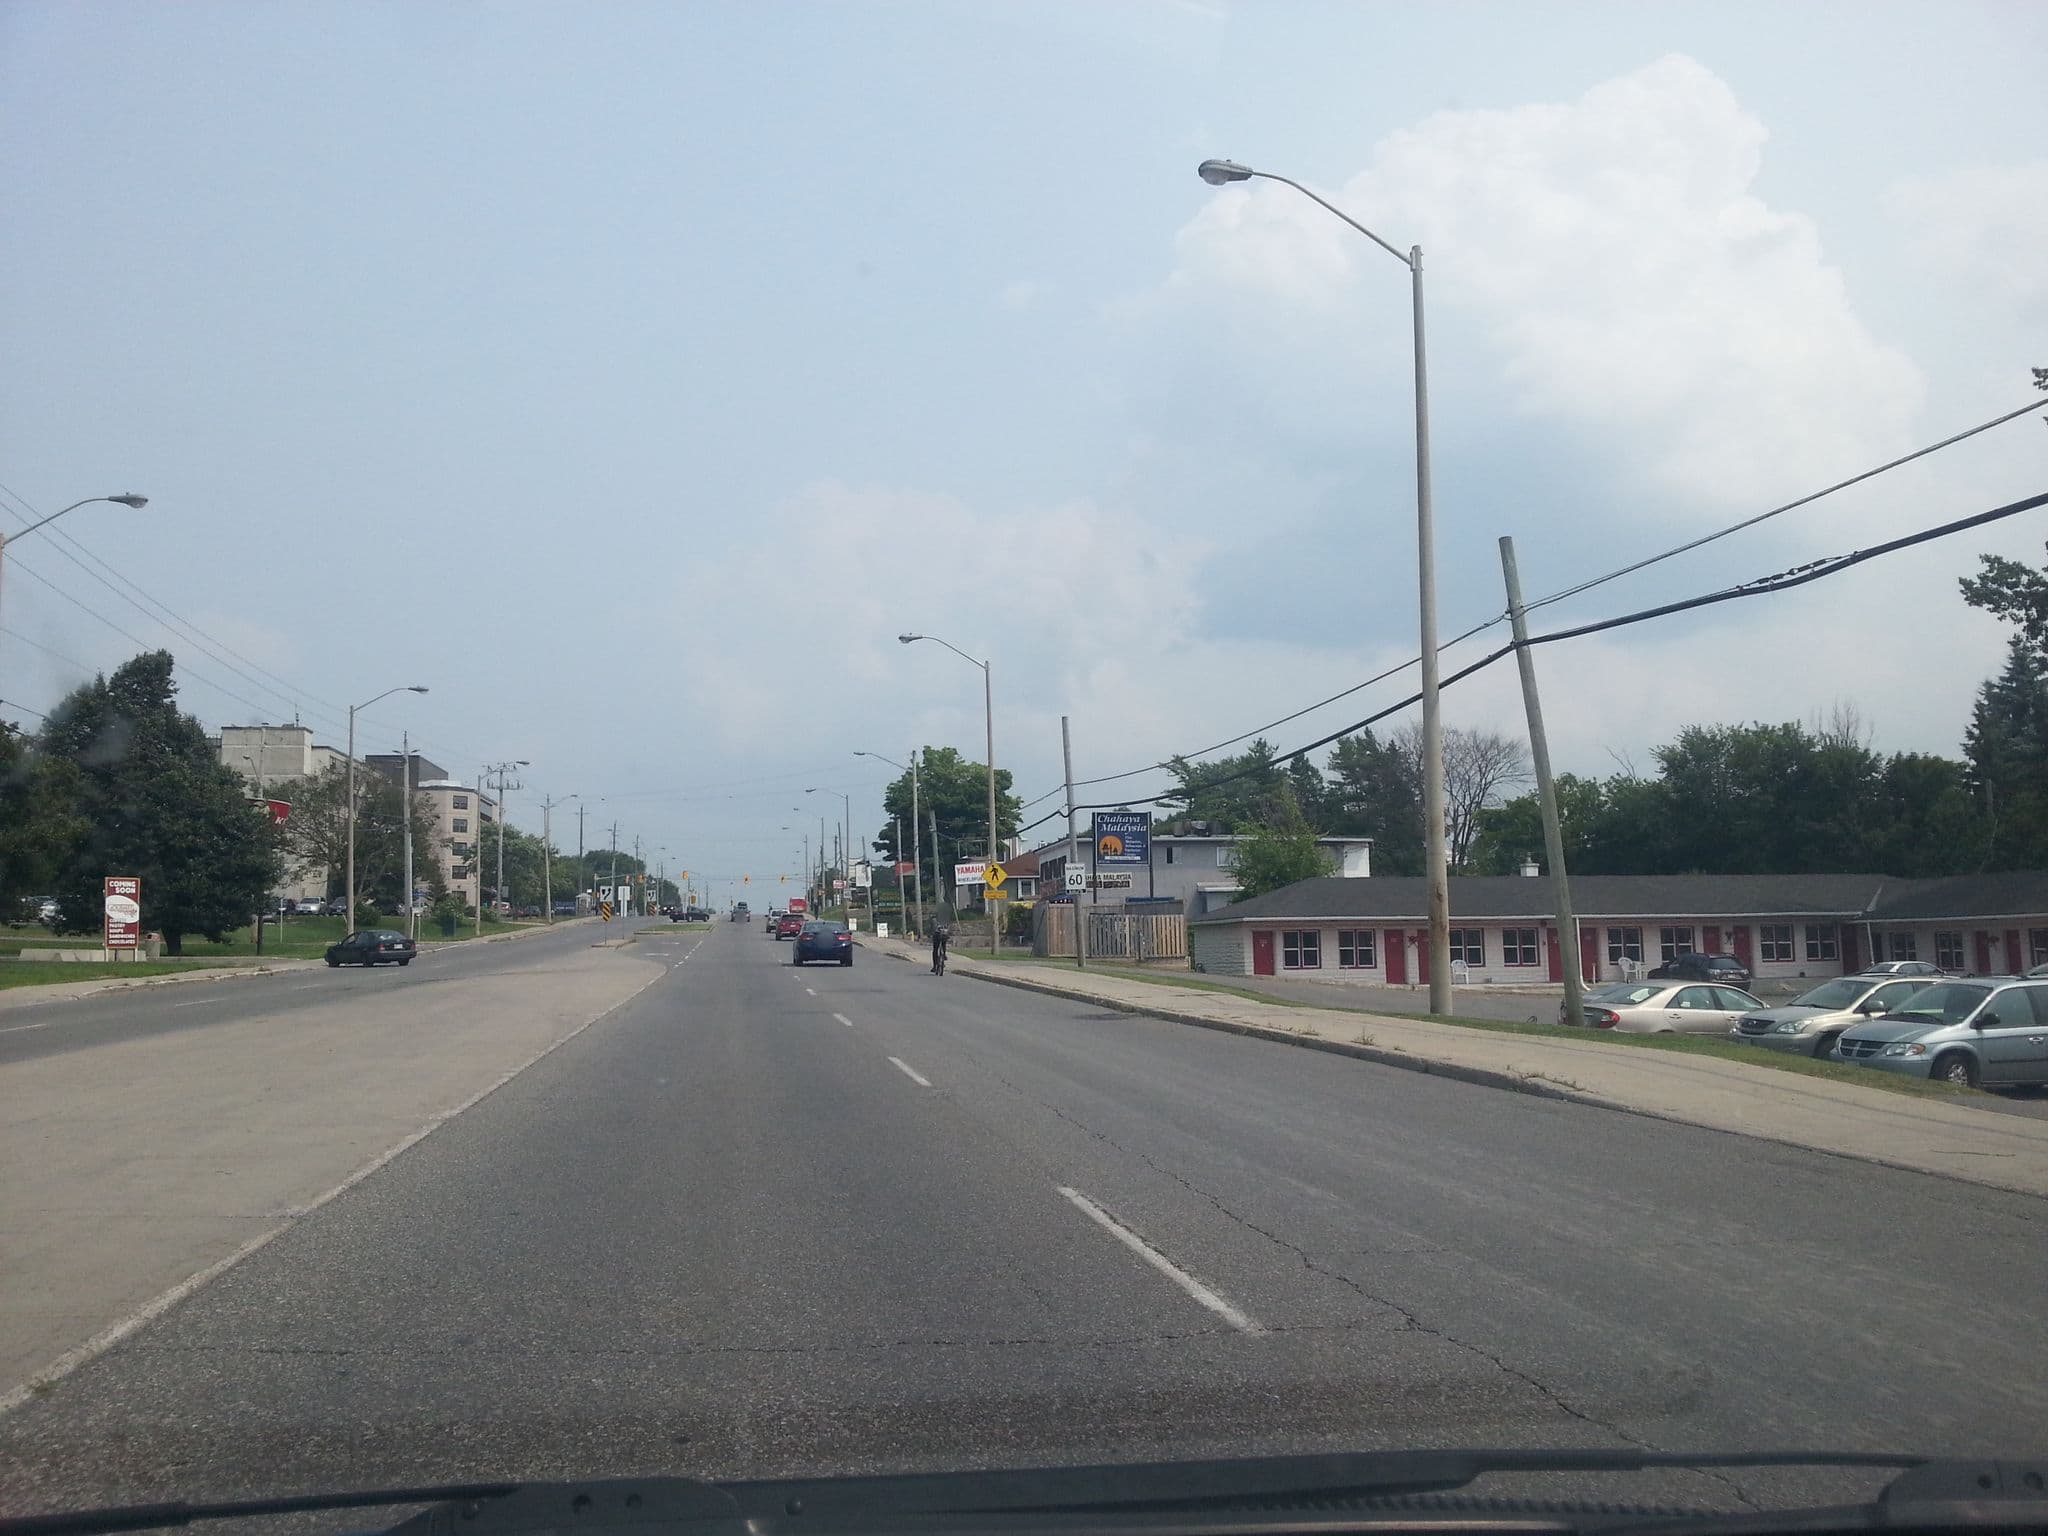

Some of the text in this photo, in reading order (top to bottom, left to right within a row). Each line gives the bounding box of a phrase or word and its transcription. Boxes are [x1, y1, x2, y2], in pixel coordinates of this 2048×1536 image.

[1097, 814, 1140, 823] Chahaya
[1100, 823, 1147, 834] Malaysia
[957, 865, 985, 874] YAMAHA
[1069, 874, 1082, 885] 60
